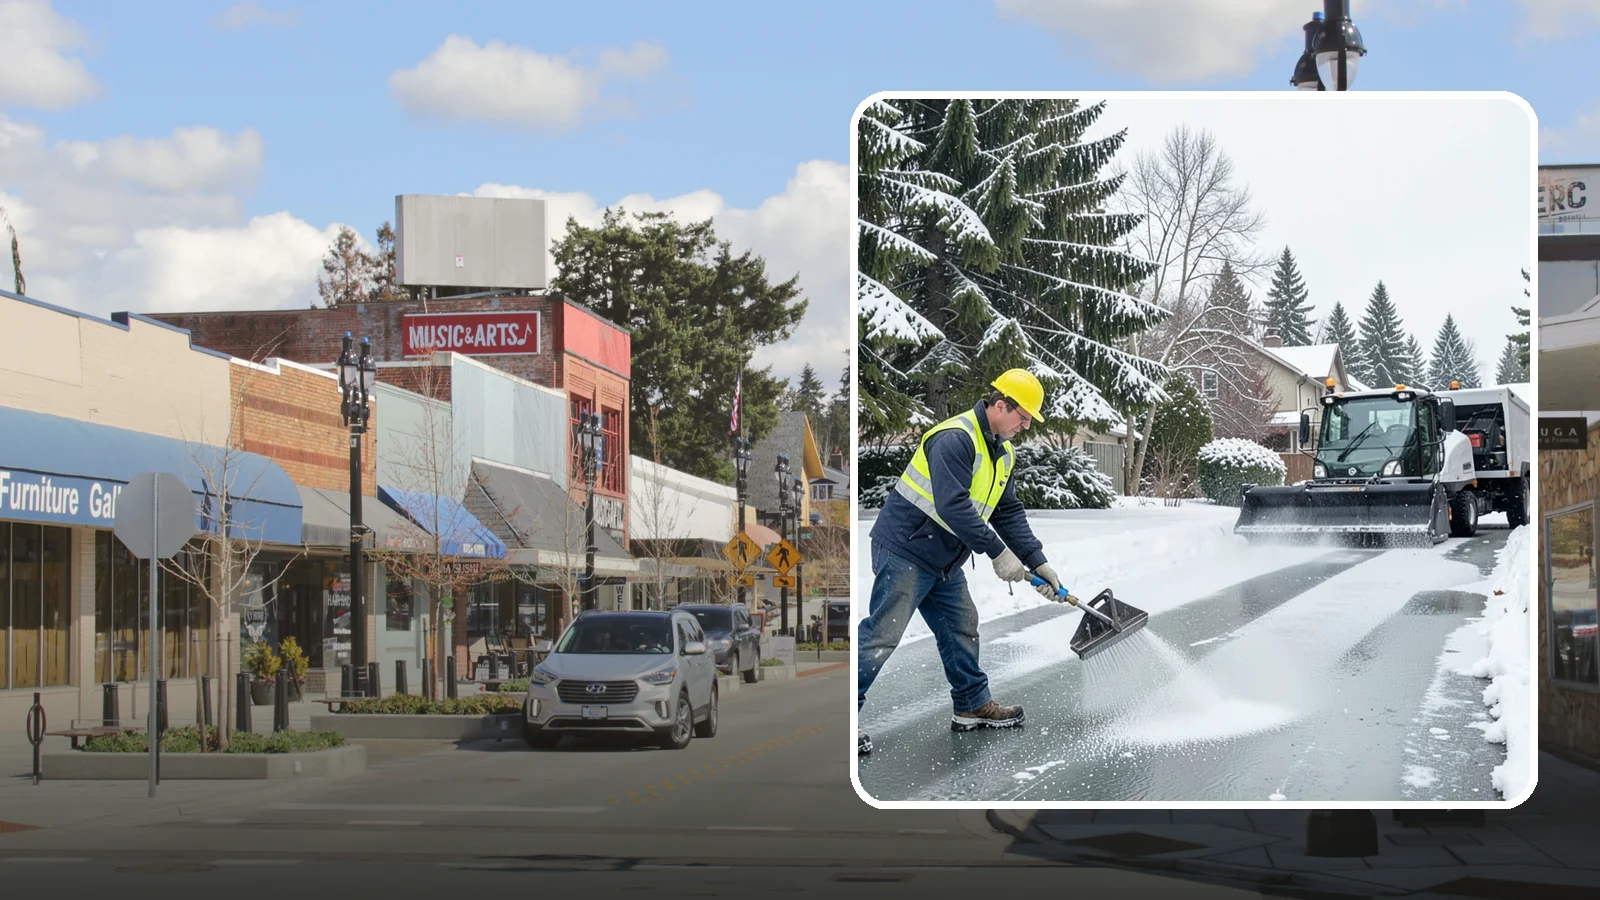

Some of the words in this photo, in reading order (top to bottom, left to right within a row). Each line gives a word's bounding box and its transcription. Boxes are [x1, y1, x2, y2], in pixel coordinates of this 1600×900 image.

[408, 322, 520, 349] MUSIC&ARTS
[1540, 427, 1578, 437] UGA
[0, 471, 79, 515] Furniture
[453, 563, 480, 574] SUSHI
